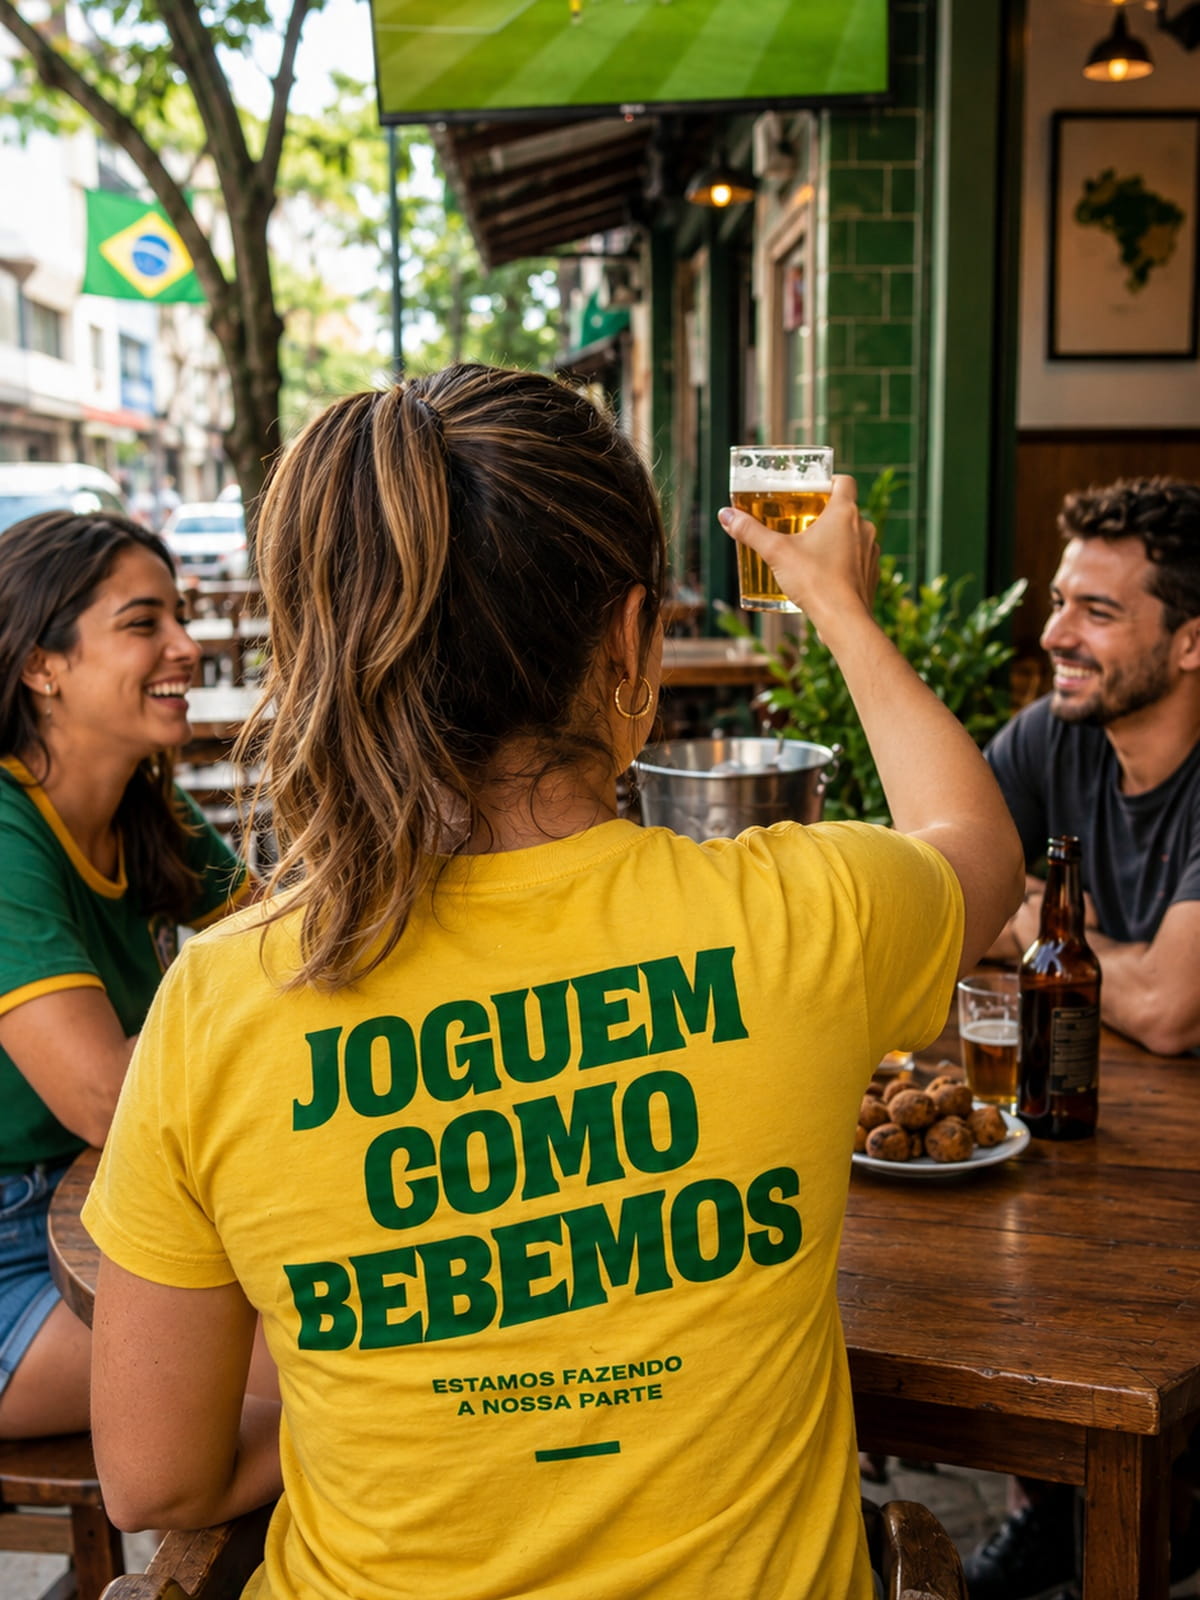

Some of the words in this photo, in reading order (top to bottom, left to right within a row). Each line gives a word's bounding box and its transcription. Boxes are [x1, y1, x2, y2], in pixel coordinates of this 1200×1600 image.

[293, 946, 749, 1131] JOGUEM
[364, 1070, 699, 1230] COMO
[283, 1166, 802, 1351] BEBEMOS
[432, 1371, 555, 1394] ESTAMOS
[562, 1355, 683, 1385] FAZENDO
[457, 1401, 475, 1416] A
[482, 1395, 571, 1414] NOSSA
[579, 1384, 663, 1409] PARTE
